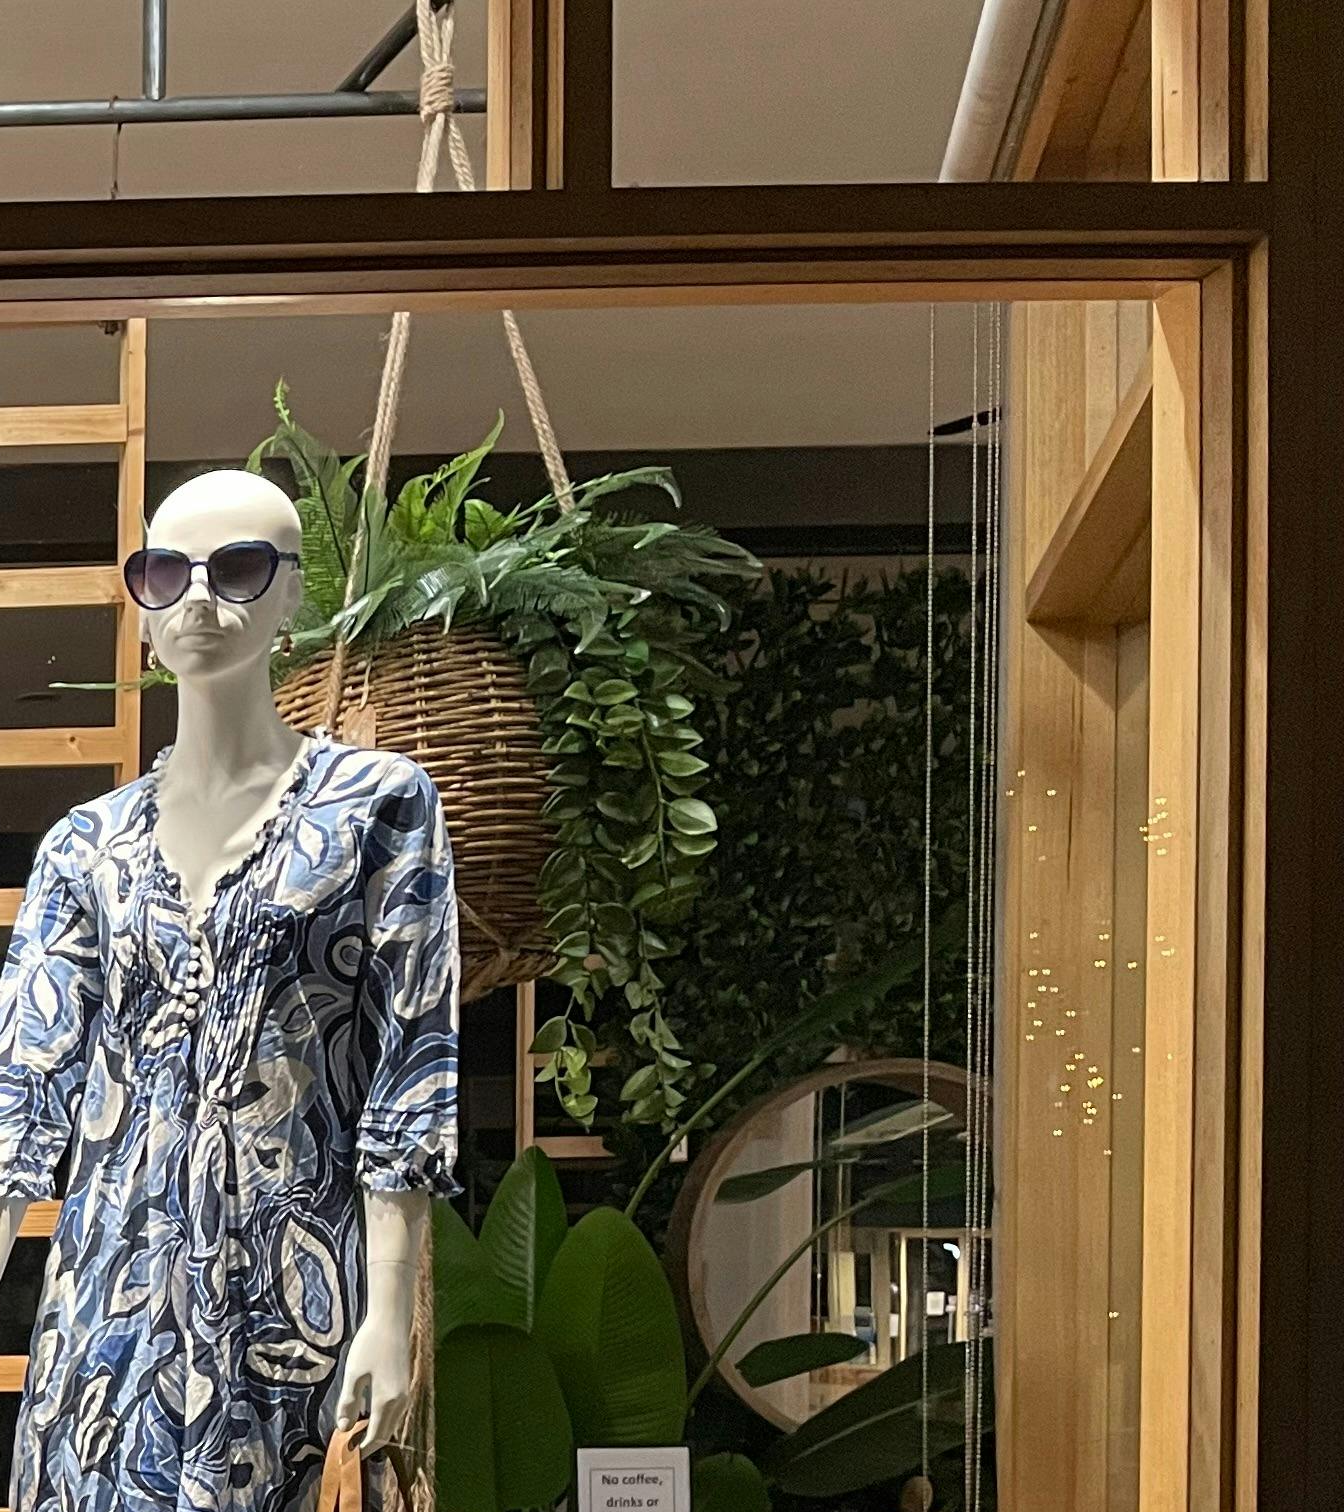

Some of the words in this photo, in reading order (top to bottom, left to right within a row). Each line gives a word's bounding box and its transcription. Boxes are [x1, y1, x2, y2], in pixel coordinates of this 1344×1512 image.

[601, 1474, 619, 1486] No
[622, 1473, 664, 1487] coffee,
[606, 1496, 643, 1508] drinks
[646, 1498, 660, 1507] or
